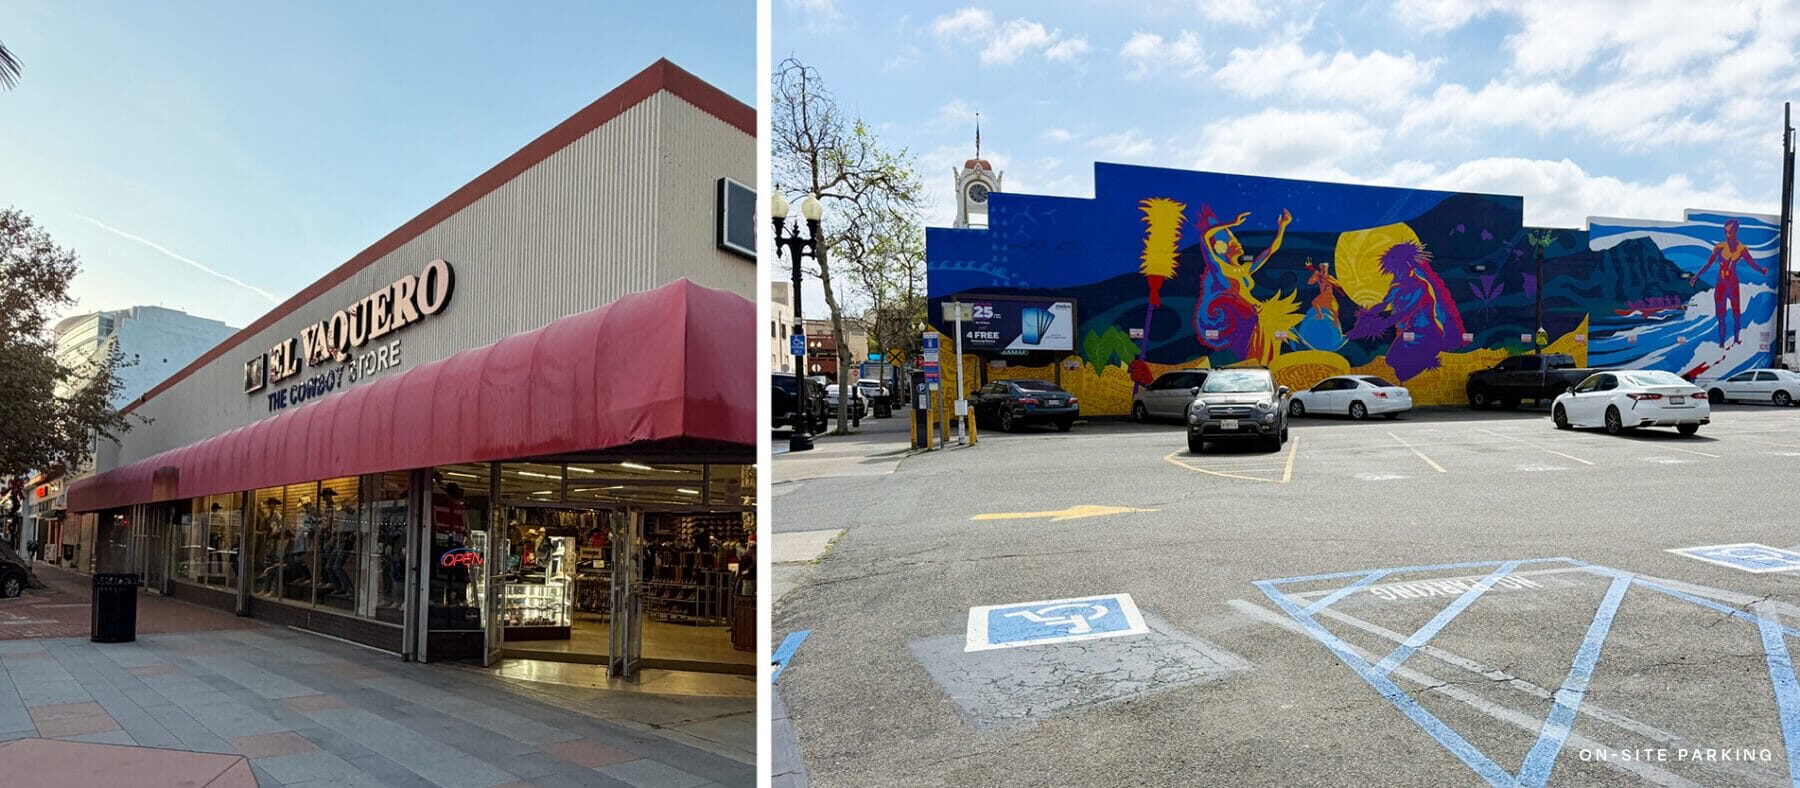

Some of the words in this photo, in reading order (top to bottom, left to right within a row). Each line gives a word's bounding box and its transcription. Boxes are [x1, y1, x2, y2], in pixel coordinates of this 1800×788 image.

[270, 338, 302, 384] EL
[300, 258, 456, 367] VAQUERO
[966, 331, 974, 339] 4
[975, 332, 1000, 340] FREE
[268, 390, 287, 412] THE
[289, 365, 344, 405] COWBOY
[348, 339, 401, 383] STORE
[442, 552, 484, 567] OPEN
